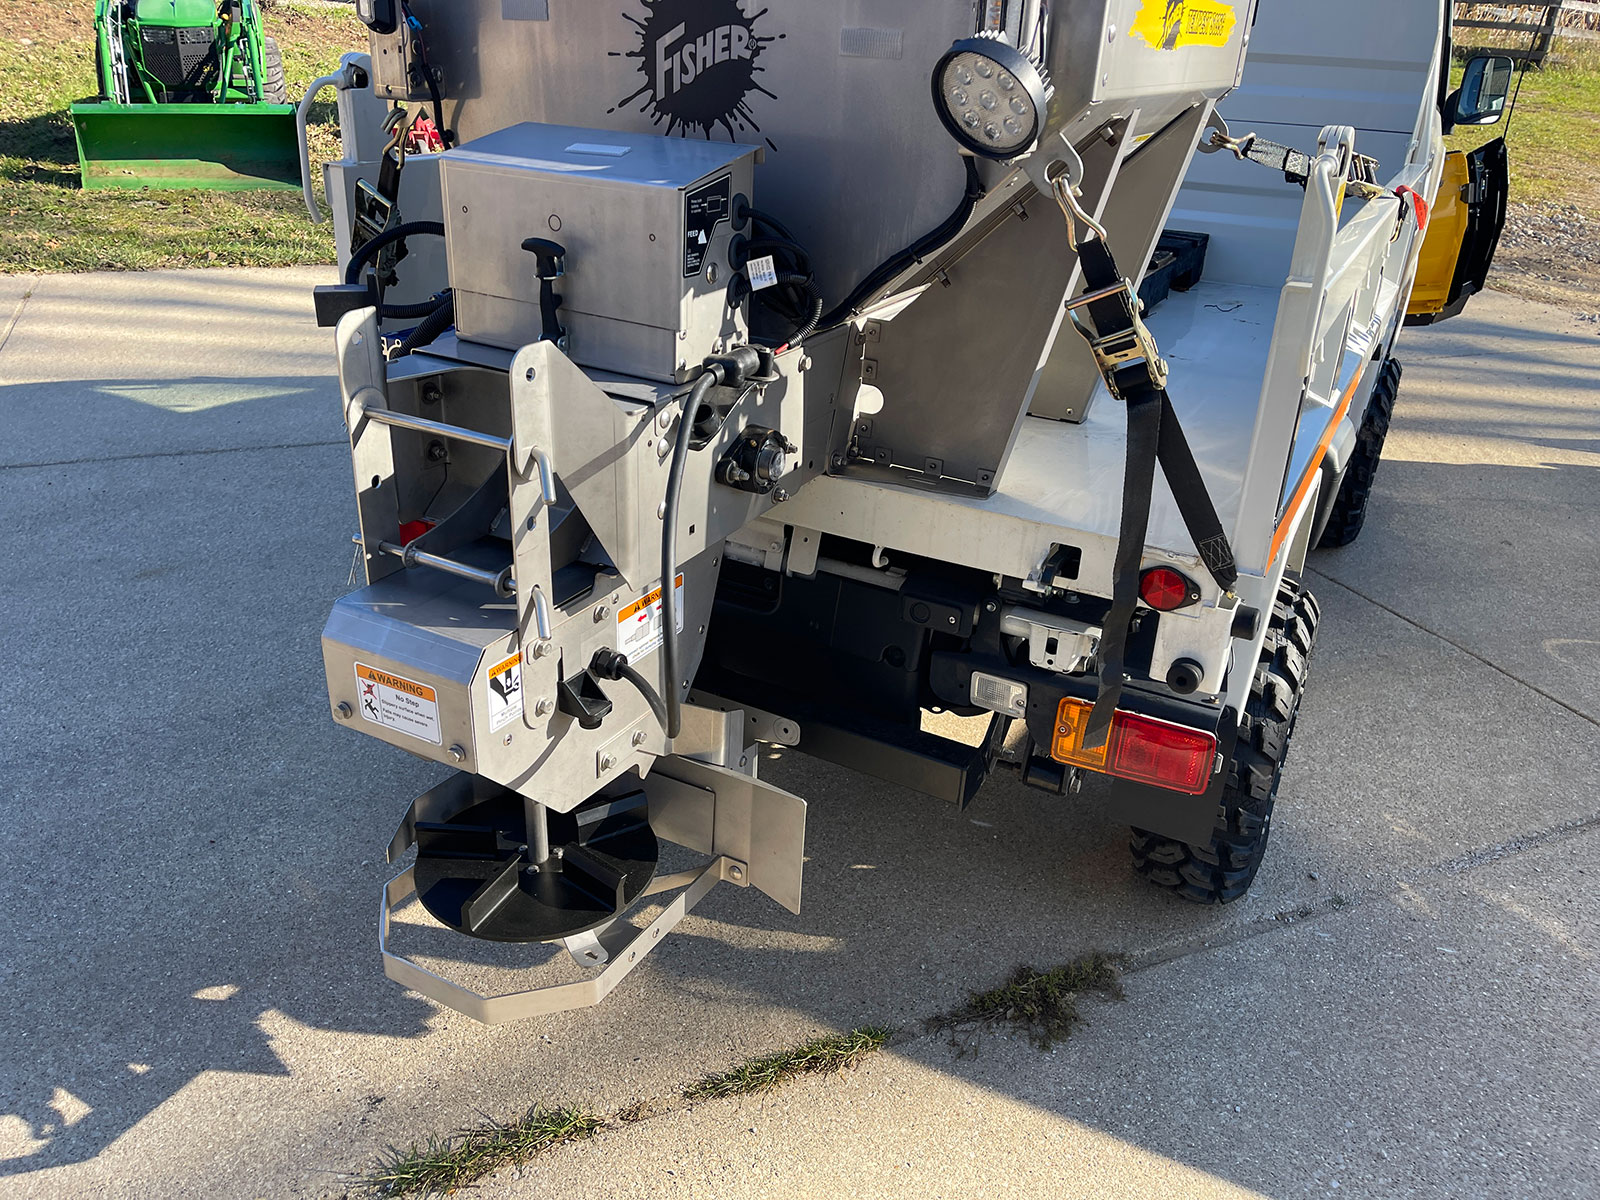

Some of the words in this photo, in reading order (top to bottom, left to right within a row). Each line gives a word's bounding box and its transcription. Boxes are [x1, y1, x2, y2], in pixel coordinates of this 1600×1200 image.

[656, 21, 753, 102] FISHER
[687, 229, 699, 238] FEED
[377, 673, 423, 697] WARNING
[381, 699, 398, 710] Slippery
[398, 705, 414, 715] surface
[395, 694, 404, 703] No
[405, 697, 420, 708] Step
